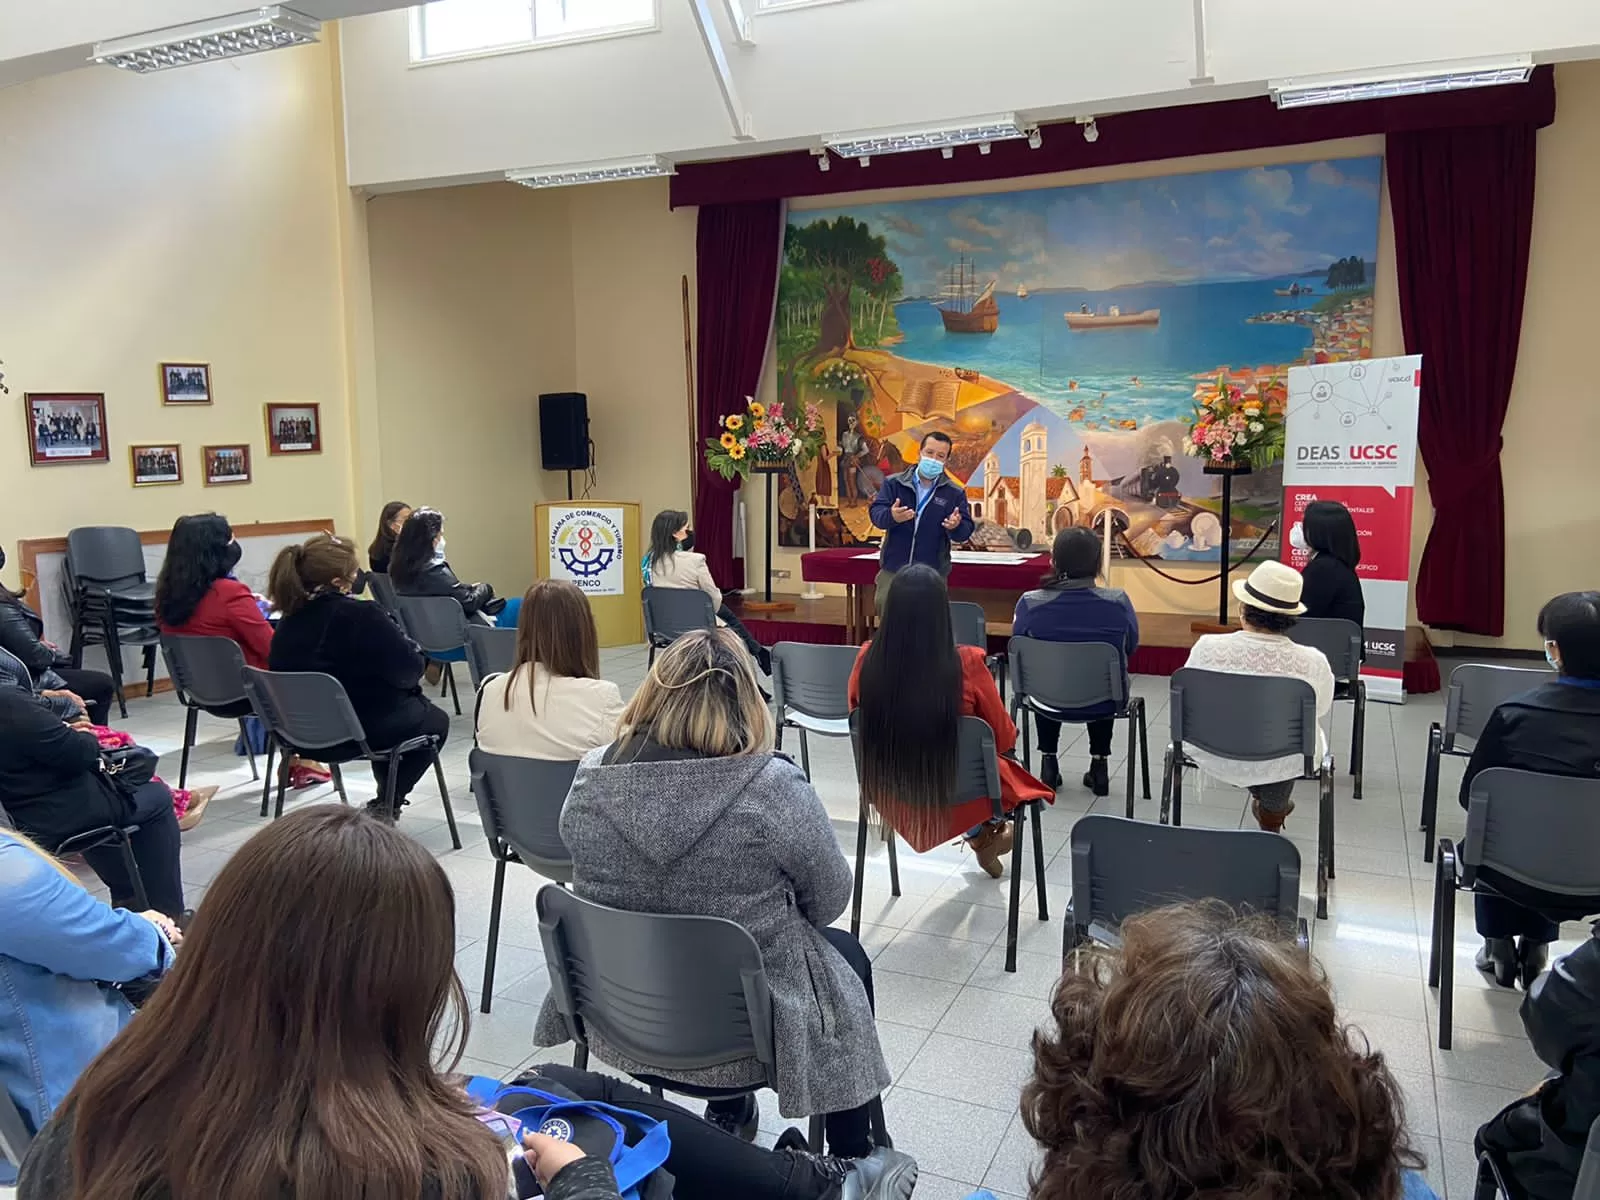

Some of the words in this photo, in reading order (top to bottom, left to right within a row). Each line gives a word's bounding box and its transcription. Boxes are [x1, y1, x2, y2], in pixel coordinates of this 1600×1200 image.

[1297, 445, 1340, 460] DEAS
[1349, 444, 1398, 459] UCSC
[1295, 493, 1318, 501] CREA
[565, 512, 575, 520] DE
[575, 510, 611, 524] COMERCIO
[1371, 641, 1396, 651] UCSC
